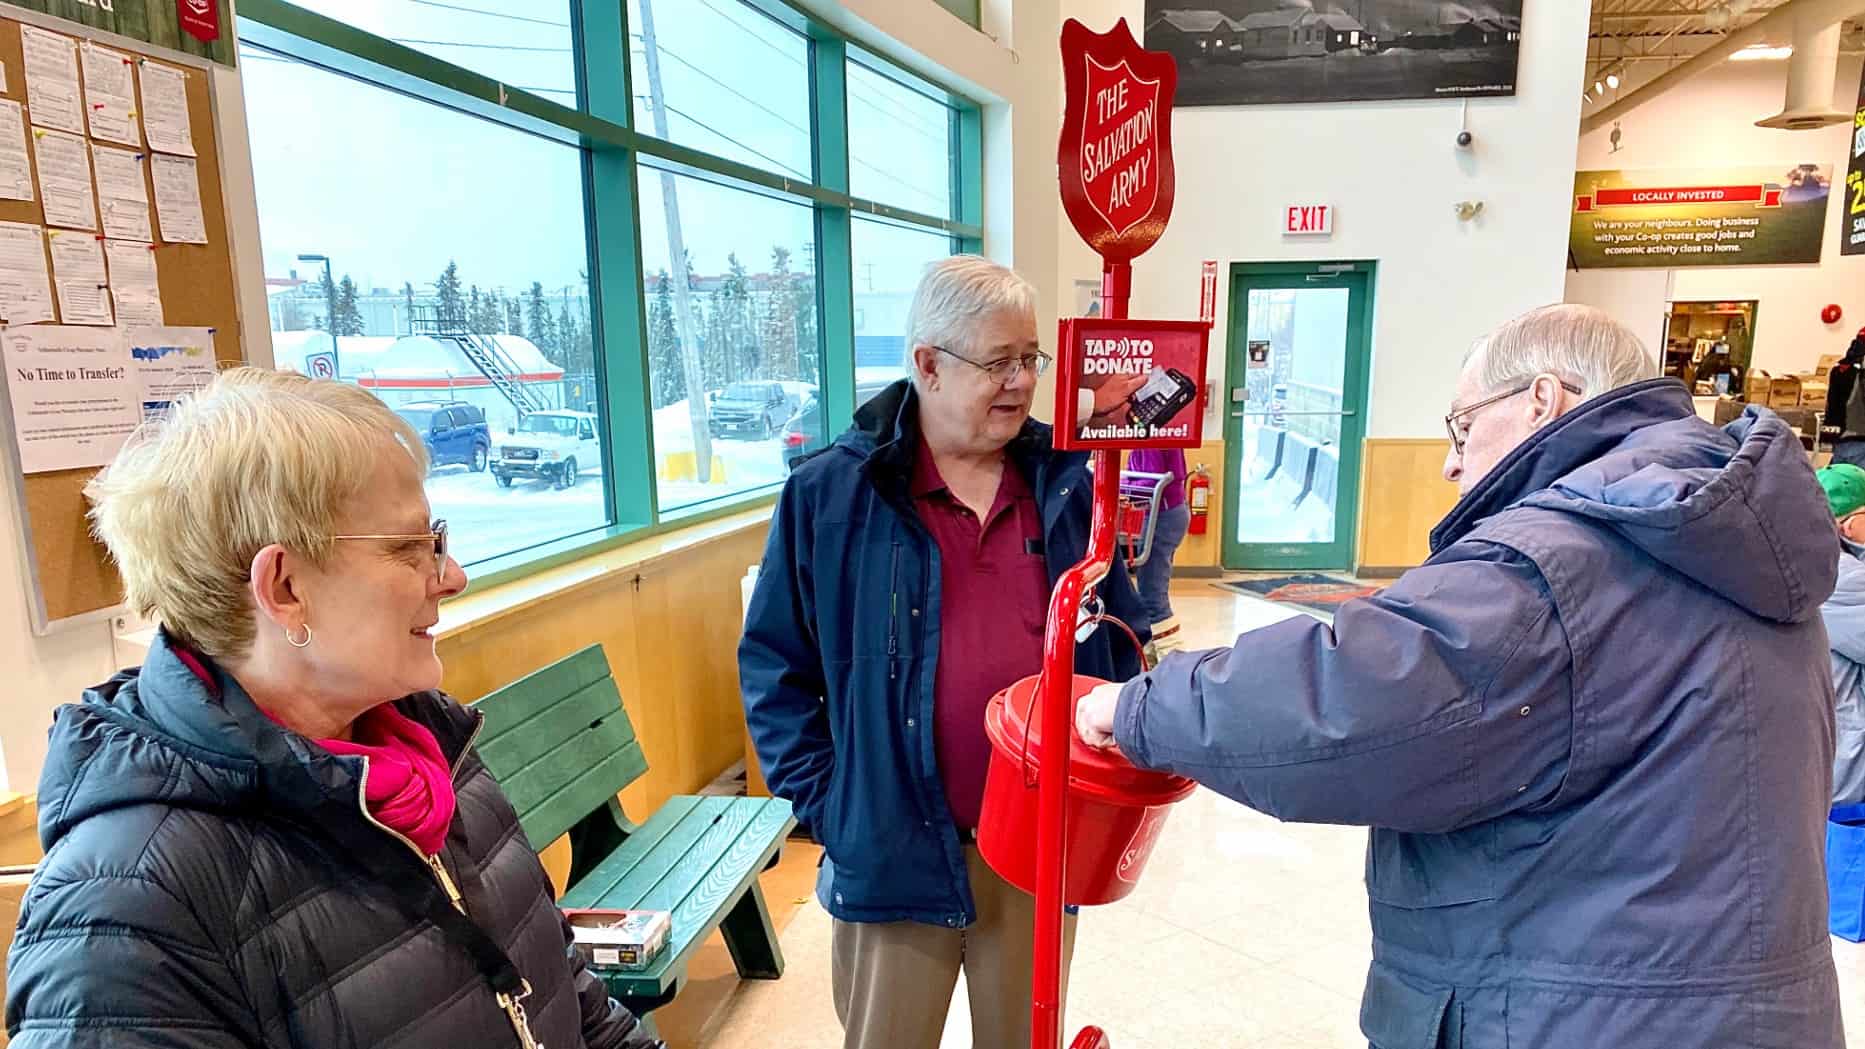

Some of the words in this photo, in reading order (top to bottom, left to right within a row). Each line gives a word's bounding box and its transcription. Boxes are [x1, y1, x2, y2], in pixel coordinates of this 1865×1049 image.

[1096, 78, 1129, 125] THE
[1084, 99, 1153, 183] SALVATION
[1108, 147, 1151, 214] ARMY
[1632, 191, 1674, 201] LOCALLY
[1677, 190, 1724, 200] INVESTED
[1288, 206, 1327, 231] EXIT
[1593, 220, 1607, 229] We
[1623, 221, 1643, 230] your
[1696, 217, 1721, 228] Doing
[1722, 216, 1759, 226] business
[1594, 232, 1614, 242] with
[1614, 234, 1634, 244] your
[1635, 232, 1661, 242] Co-op
[1663, 231, 1694, 240] creates
[1695, 230, 1717, 242] good
[1717, 229, 1737, 242] jobs
[1738, 228, 1755, 239] and
[1604, 245, 1645, 255] economic
[1646, 244, 1679, 256] activity
[1680, 243, 1701, 253] close
[1703, 244, 1713, 253] to
[1714, 242, 1742, 252] home.
[1084, 340, 1117, 356] TAP
[1130, 340, 1154, 356] TO
[16, 367, 34, 381] No
[35, 367, 64, 381] Time
[66, 369, 76, 380] to
[78, 366, 124, 380] Transfer?
[1083, 358, 1153, 375] DONATE
[1080, 424, 1147, 439] Available
[1149, 423, 1188, 437] here!
